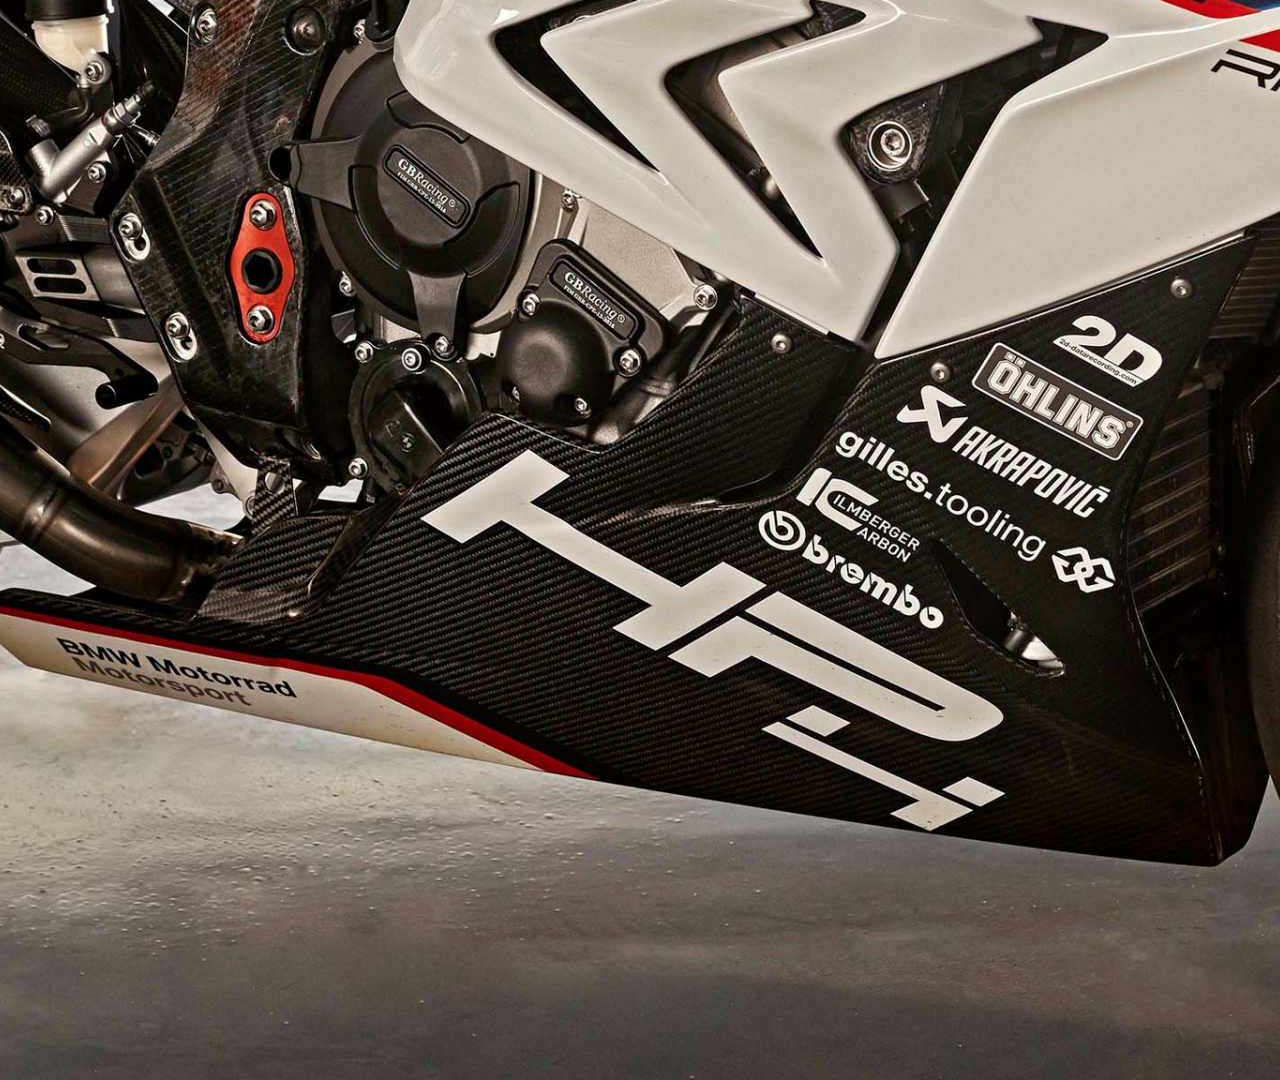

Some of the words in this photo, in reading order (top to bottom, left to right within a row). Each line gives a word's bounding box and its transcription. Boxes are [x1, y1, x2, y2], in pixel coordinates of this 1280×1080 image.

[1053, 315, 1162, 387] 2D
[1059, 338, 1137, 385] 2d-datarecording.com
[987, 352, 1127, 449] ÖHLINS
[833, 494, 920, 551] ILMBERGER
[835, 431, 1047, 562] gilles.tooling
[802, 534, 944, 629] brembo
[57, 637, 141, 668] BMW
[146, 655, 297, 698] Motorrad
[421, 449, 1005, 831] HP4
[72, 657, 252, 706] Motorsport
